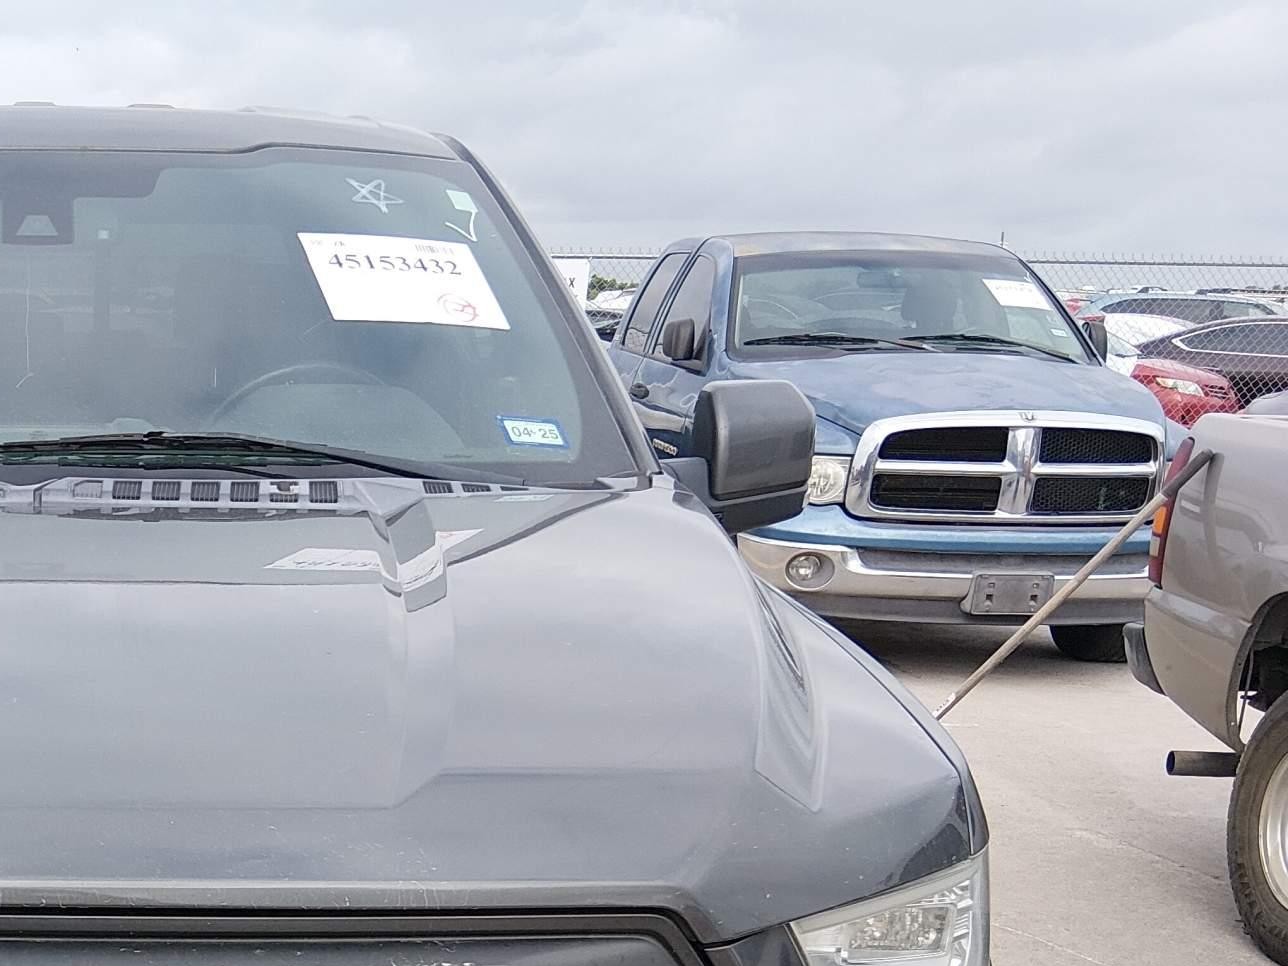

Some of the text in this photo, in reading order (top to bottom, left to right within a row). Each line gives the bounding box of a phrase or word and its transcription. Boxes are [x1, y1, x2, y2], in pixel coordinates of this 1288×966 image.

[328, 253, 462, 276] 45153432
[511, 426, 559, 440] 04 25
